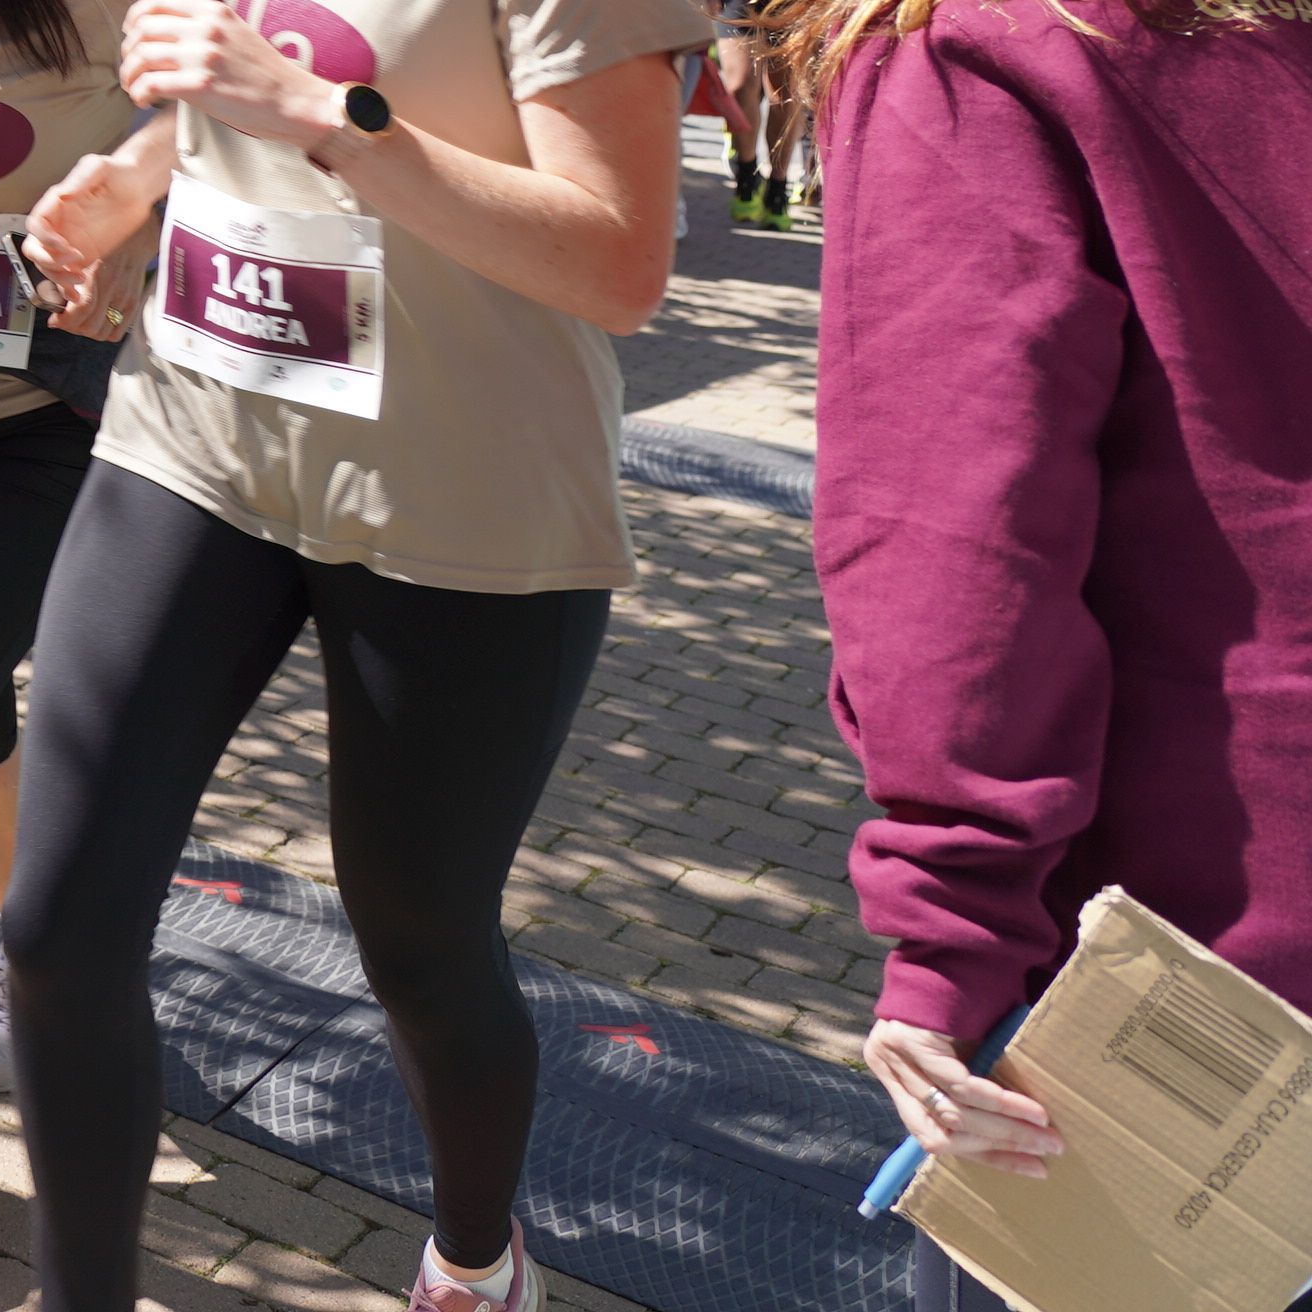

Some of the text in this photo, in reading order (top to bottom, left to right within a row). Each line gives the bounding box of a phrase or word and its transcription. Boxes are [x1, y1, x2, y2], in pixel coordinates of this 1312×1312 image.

[210, 253, 294, 312] 141
[203, 296, 311, 347] ANDREA
[1248, 1099, 1289, 1137] CAJA
[1204, 1131, 1262, 1193] GENERICA
